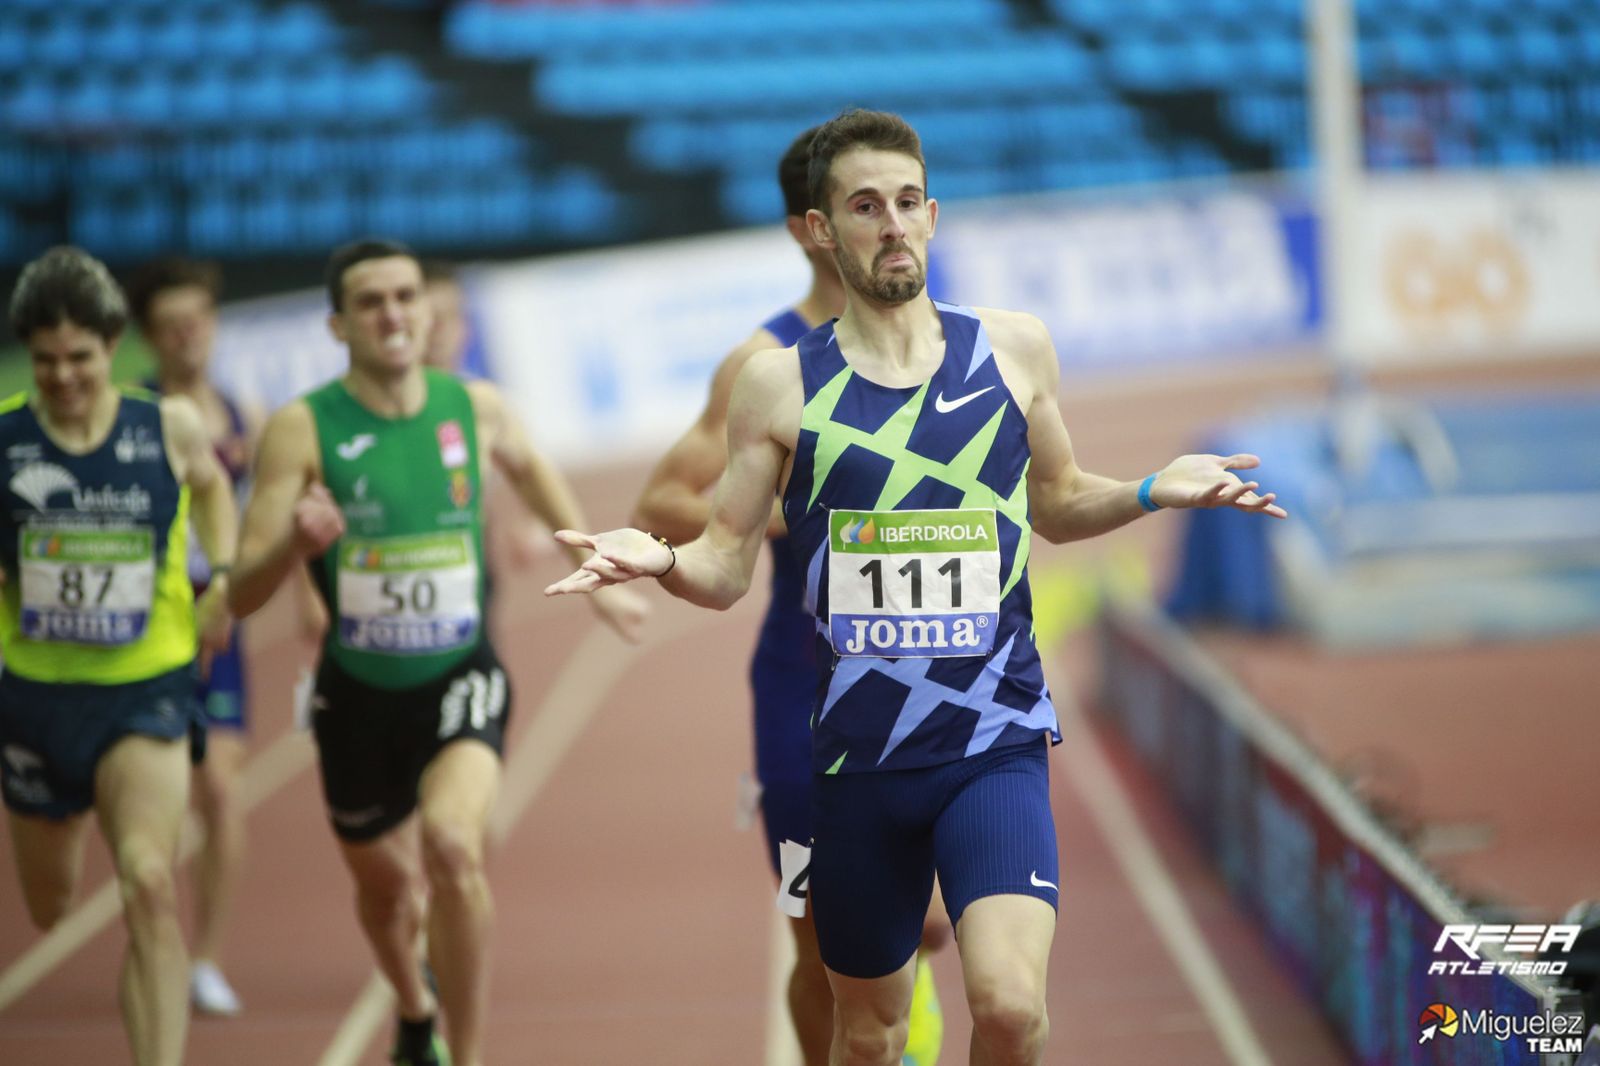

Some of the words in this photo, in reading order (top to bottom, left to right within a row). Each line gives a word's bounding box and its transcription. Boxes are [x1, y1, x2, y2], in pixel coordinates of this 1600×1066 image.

[879, 524, 988, 543] IBERDROLA
[60, 567, 115, 606] 87
[381, 578, 436, 614] 50
[859, 557, 962, 609] 111
